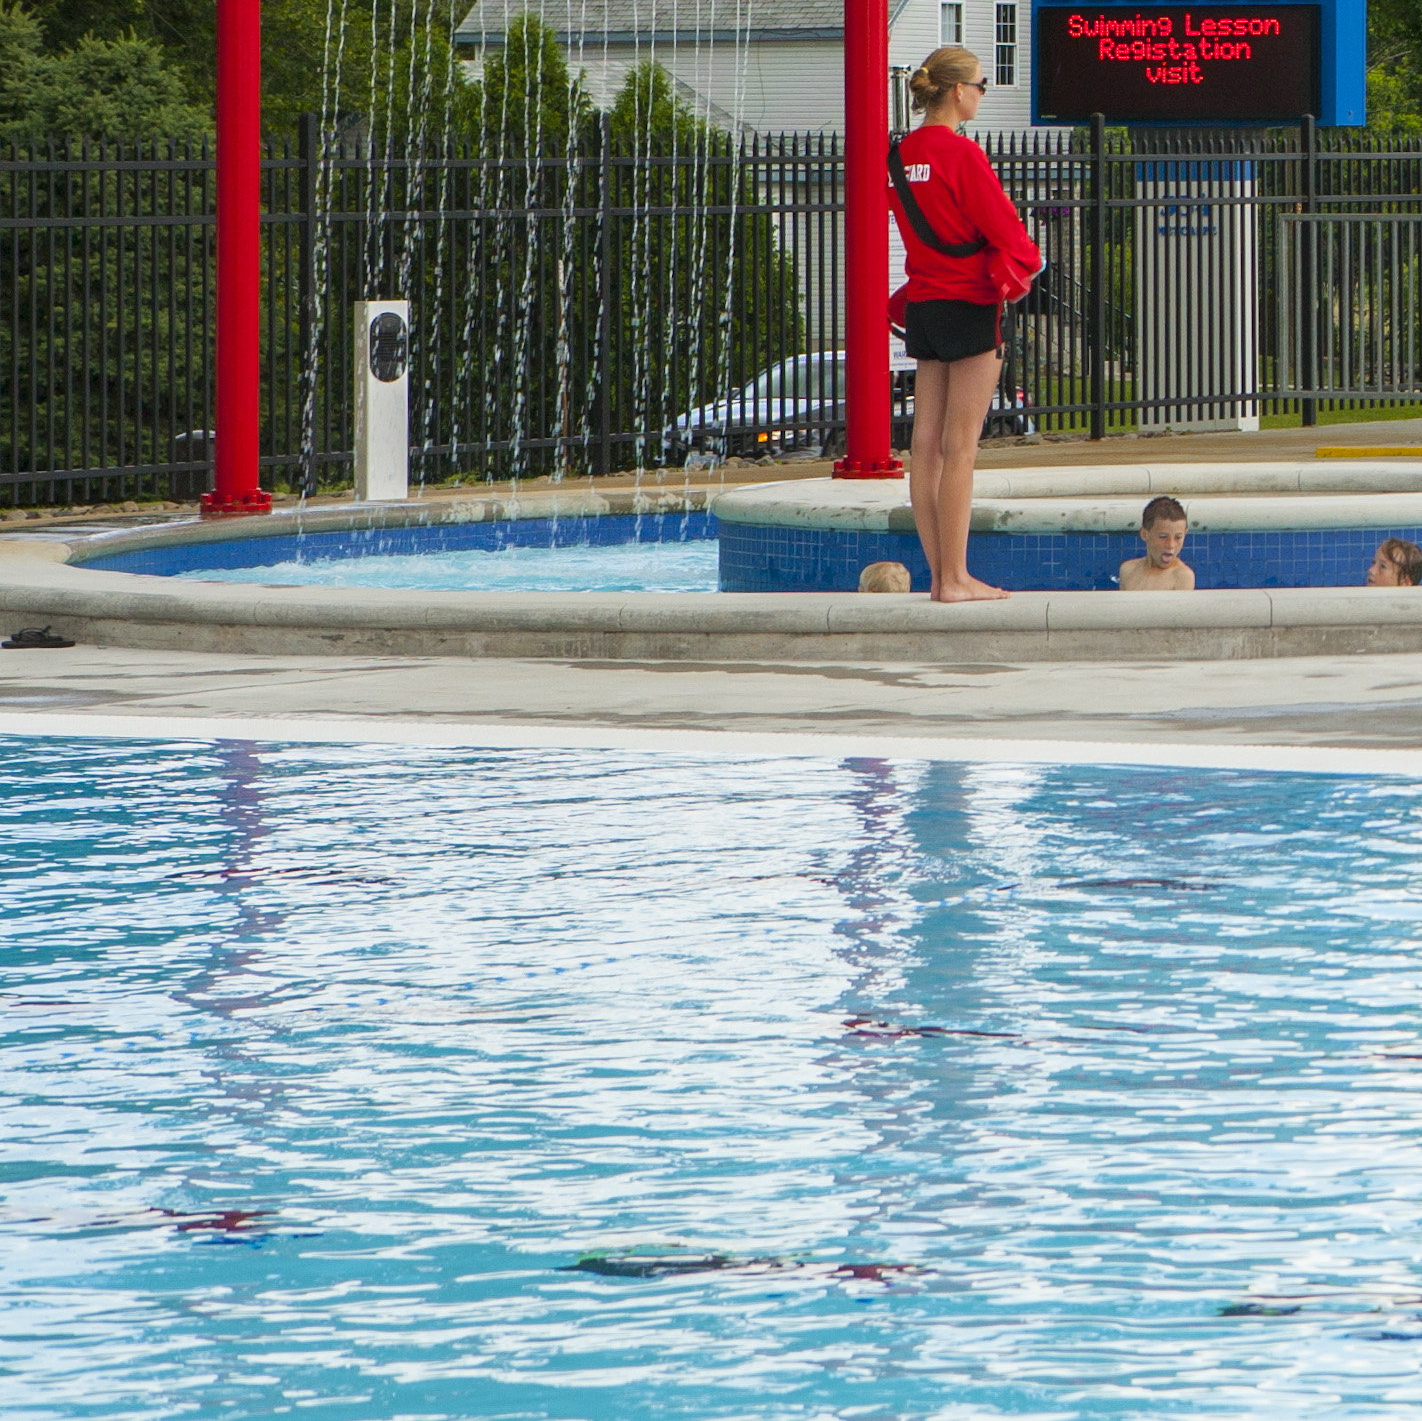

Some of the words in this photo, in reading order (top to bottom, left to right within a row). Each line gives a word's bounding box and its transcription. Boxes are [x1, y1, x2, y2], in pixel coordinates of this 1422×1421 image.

[1185, 13, 1281, 37] Lesson
[1099, 37, 1252, 61] Registation
[1146, 61, 1204, 84] visit
